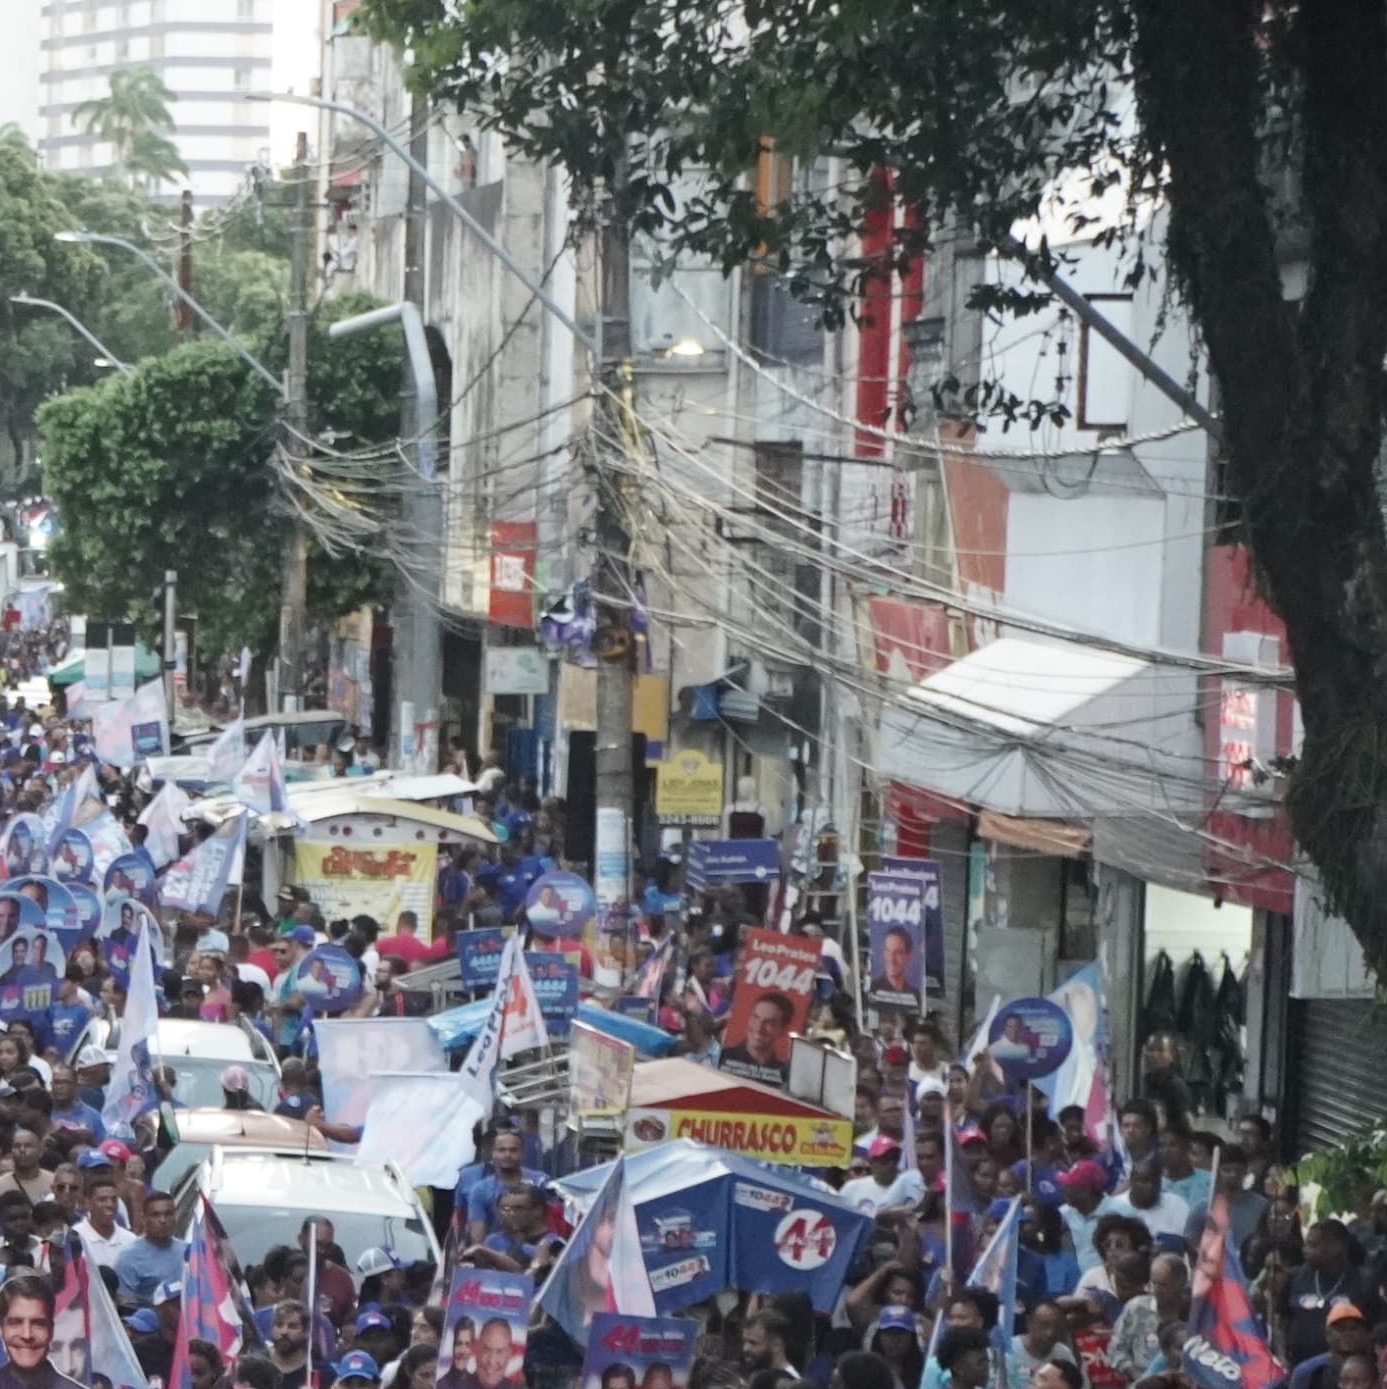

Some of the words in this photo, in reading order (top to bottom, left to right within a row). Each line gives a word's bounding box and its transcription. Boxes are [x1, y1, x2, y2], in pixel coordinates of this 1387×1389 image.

[870, 896, 922, 924] 1044
[745, 957, 815, 995] 1044
[676, 1118, 798, 1155] CHURRASCO
